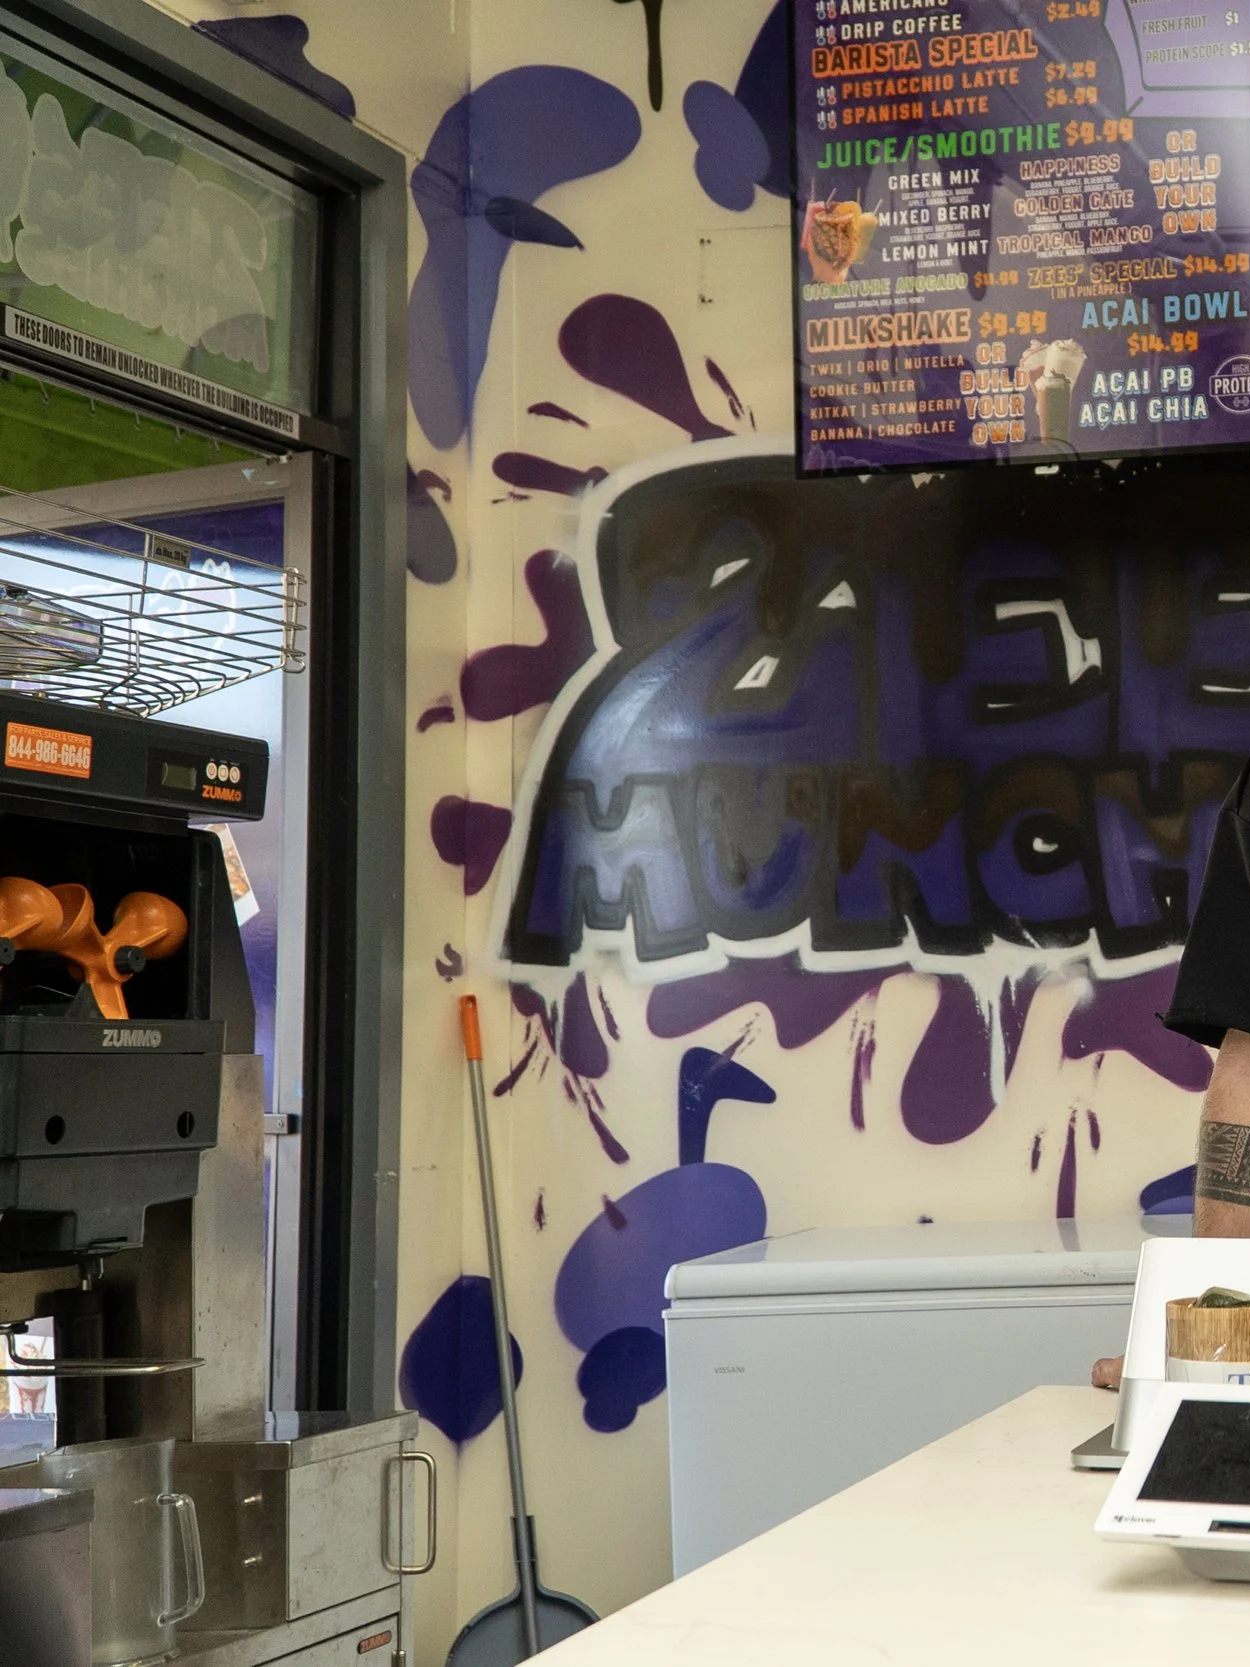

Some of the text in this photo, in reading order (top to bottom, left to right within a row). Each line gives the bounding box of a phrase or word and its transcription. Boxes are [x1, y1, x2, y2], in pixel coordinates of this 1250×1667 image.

[841, 14, 962, 40] DRIP COFFEE
[1142, 9, 1239, 34] FRESH FRUIT $1
[812, 29, 1038, 78] BARISTA SPECIAL
[1146, 47, 1189, 63] PROTEIN
[1192, 43, 1225, 59] SCOPE
[842, 60, 1097, 99] PISTACCHIO LATTE $7.29
[842, 103, 924, 125] SPANISH
[932, 96, 989, 117] LATTE
[817, 118, 1133, 169] JUICE/SMOOTHIE $9.99
[1166, 129, 1197, 153] OR
[889, 168, 980, 190] GREEN MIX
[1019, 153, 1121, 180] HAPPINESS
[1149, 154, 1222, 184] BUILD
[1014, 193, 1083, 217] GOLDEN
[1089, 189, 1135, 209] GATE
[1154, 182, 1217, 209] YOUR
[878, 204, 990, 227] MIXED BERRY
[1163, 208, 1217, 234] OWN
[881, 240, 989, 262] LEMON MINT
[997, 230, 1083, 254] TROPICAL
[1089, 225, 1153, 246] MANGO
[1090, 256, 1177, 284] SPECIAL
[1184, 253, 1250, 277] $14.99
[895, 272, 969, 293] AVOCADO
[1082, 291, 1248, 331] AÇAI BOWL
[806, 308, 1048, 353] MILKSHAKE $9.99
[1127, 329, 1199, 357] $14.99
[809, 355, 964, 377] TWIX ORIO NUTELLA
[976, 342, 1006, 365] OR
[14, 313, 294, 433] THESE DOORS TO REMAIN UNLOCKED WHENEVER THE BUILDING IS OCCUPIED
[960, 368, 1030, 395] BUILD
[1160, 365, 1194, 392] PB
[1232, 363, 1250, 373] HIGH
[809, 379, 915, 398] COOKIE BUTTER
[810, 398, 961, 420] KITKAT STRAWBERRY
[965, 393, 1025, 420] YOUR
[1148, 395, 1209, 424] CHIA
[810, 420, 956, 442] BANANA CHOCOLATE
[973, 419, 1025, 446] OWN
[202, 784, 242, 802] ZUMMO
[102, 1028, 162, 1047] ZUMMO
[714, 1366, 745, 1375] VISSANI
